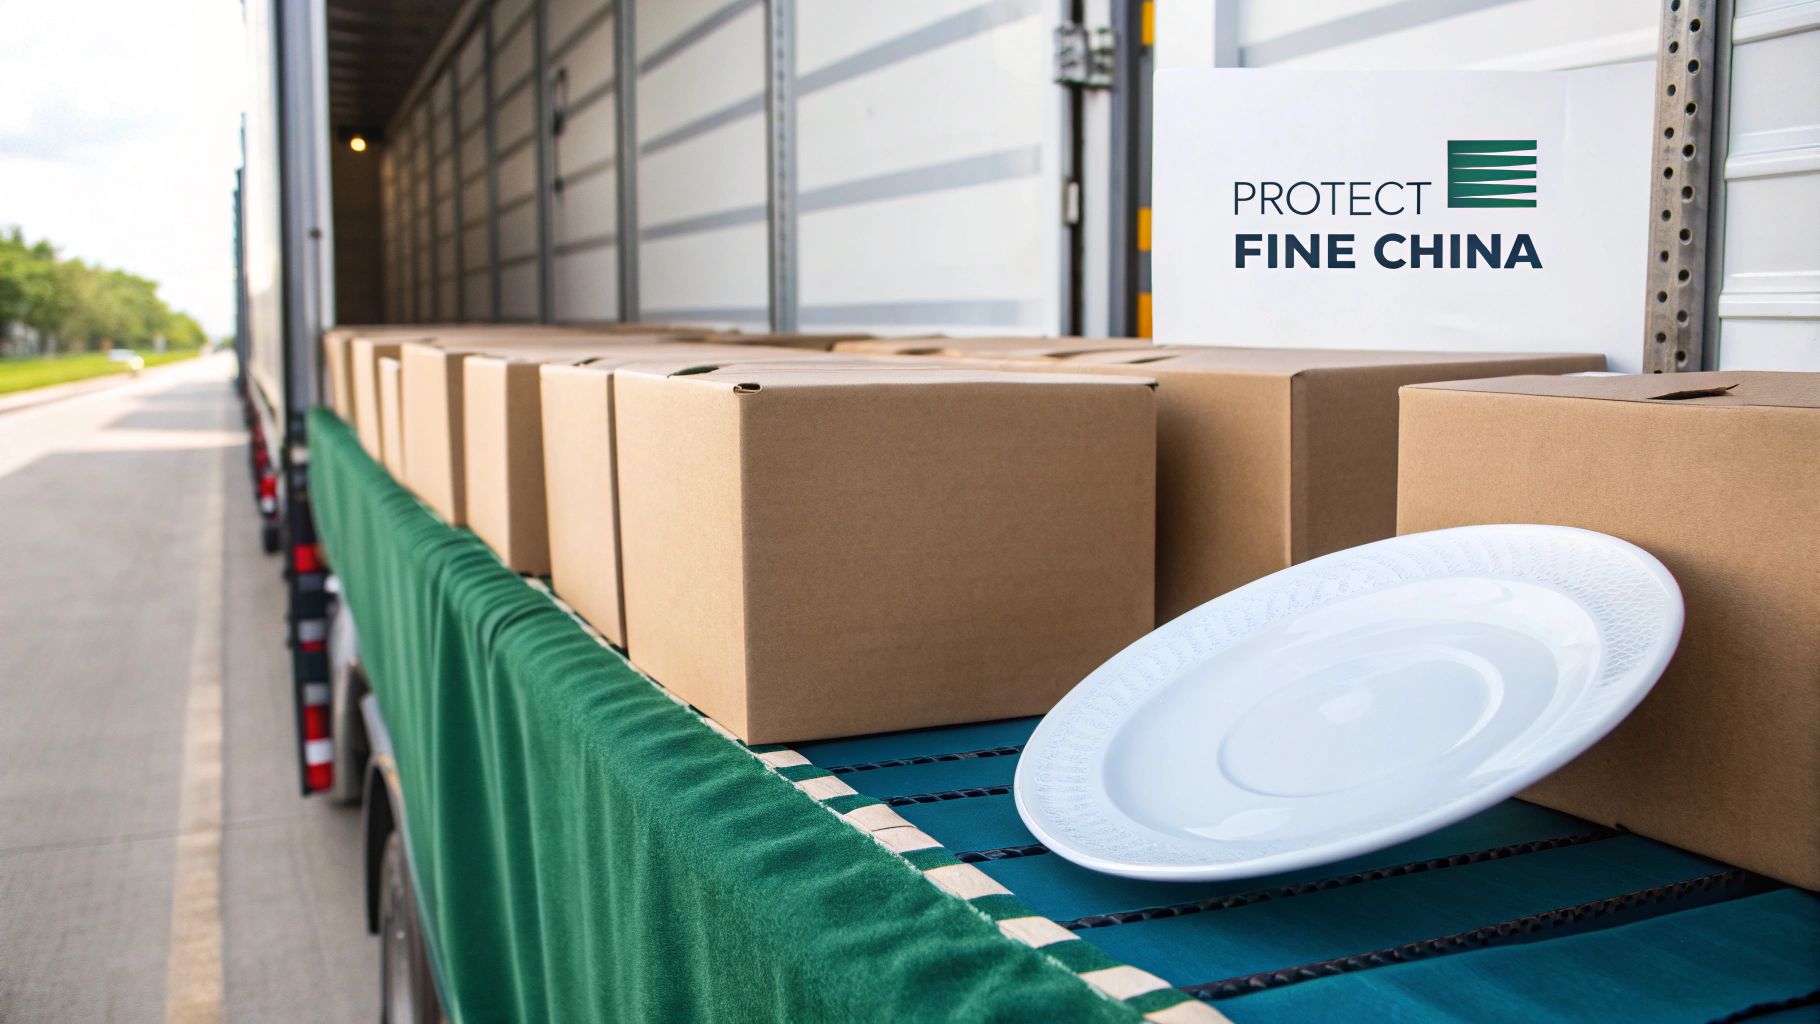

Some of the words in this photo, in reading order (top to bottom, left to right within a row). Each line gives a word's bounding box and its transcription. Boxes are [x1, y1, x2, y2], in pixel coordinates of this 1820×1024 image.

[1234, 181, 1432, 216] PROTECT
[1235, 233, 1356, 269] FINE
[1373, 232, 1543, 270] CHINA
